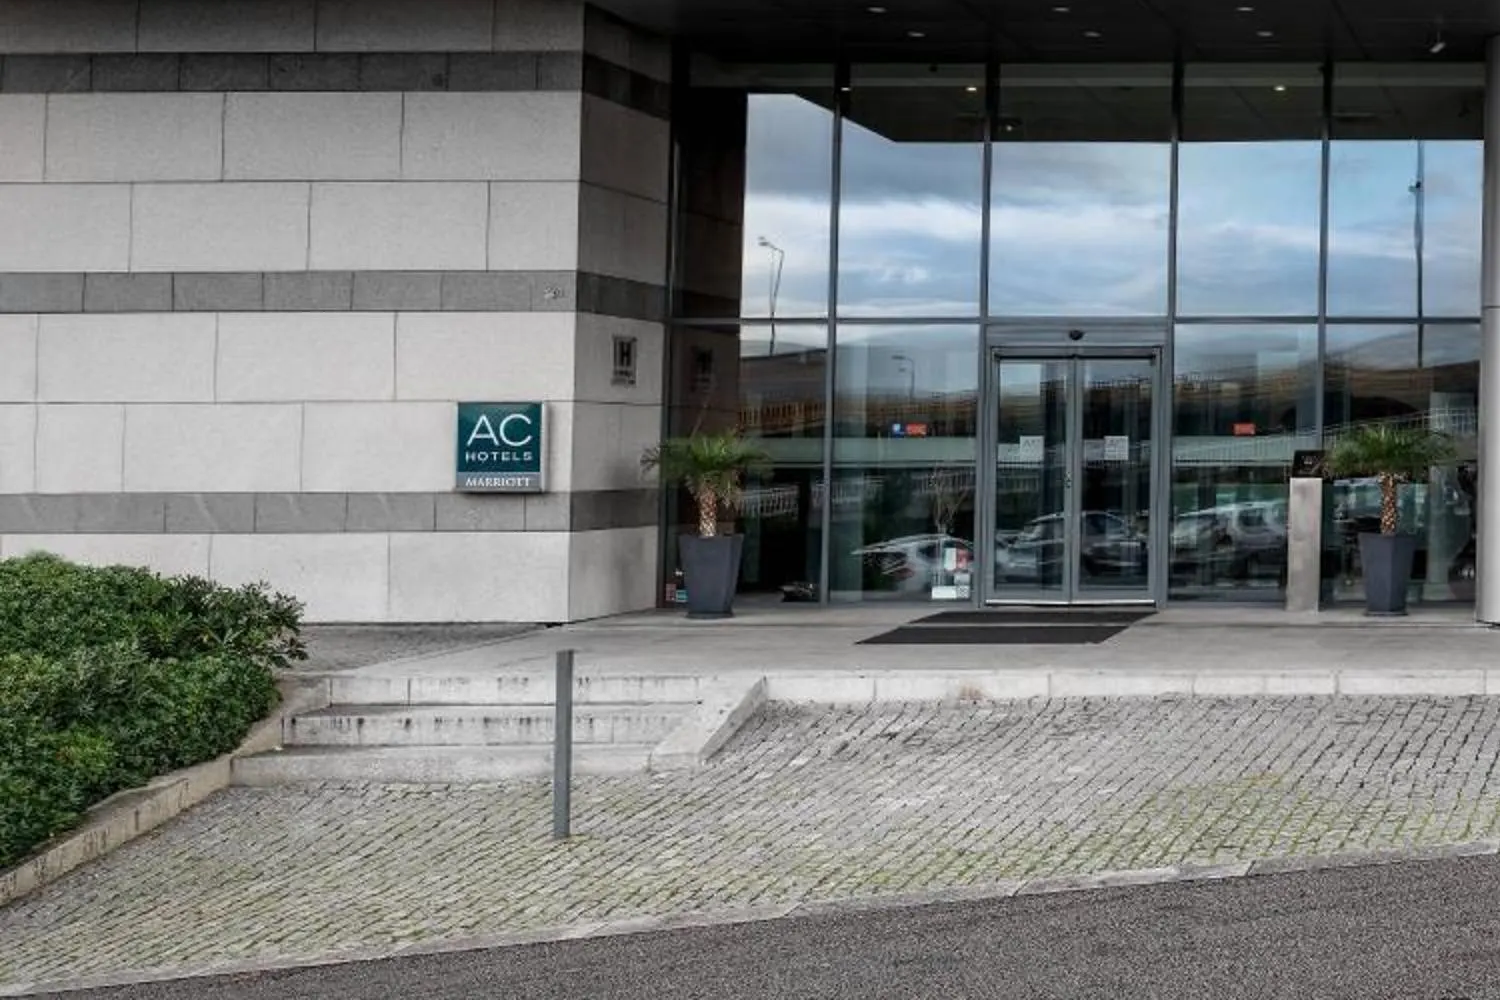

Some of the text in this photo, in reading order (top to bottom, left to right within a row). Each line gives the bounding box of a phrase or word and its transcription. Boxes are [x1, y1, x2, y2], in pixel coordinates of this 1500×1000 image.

[466, 413, 532, 447] AC
[465, 451, 533, 462] HOTELS
[465, 477, 531, 487] MARRIOTT
